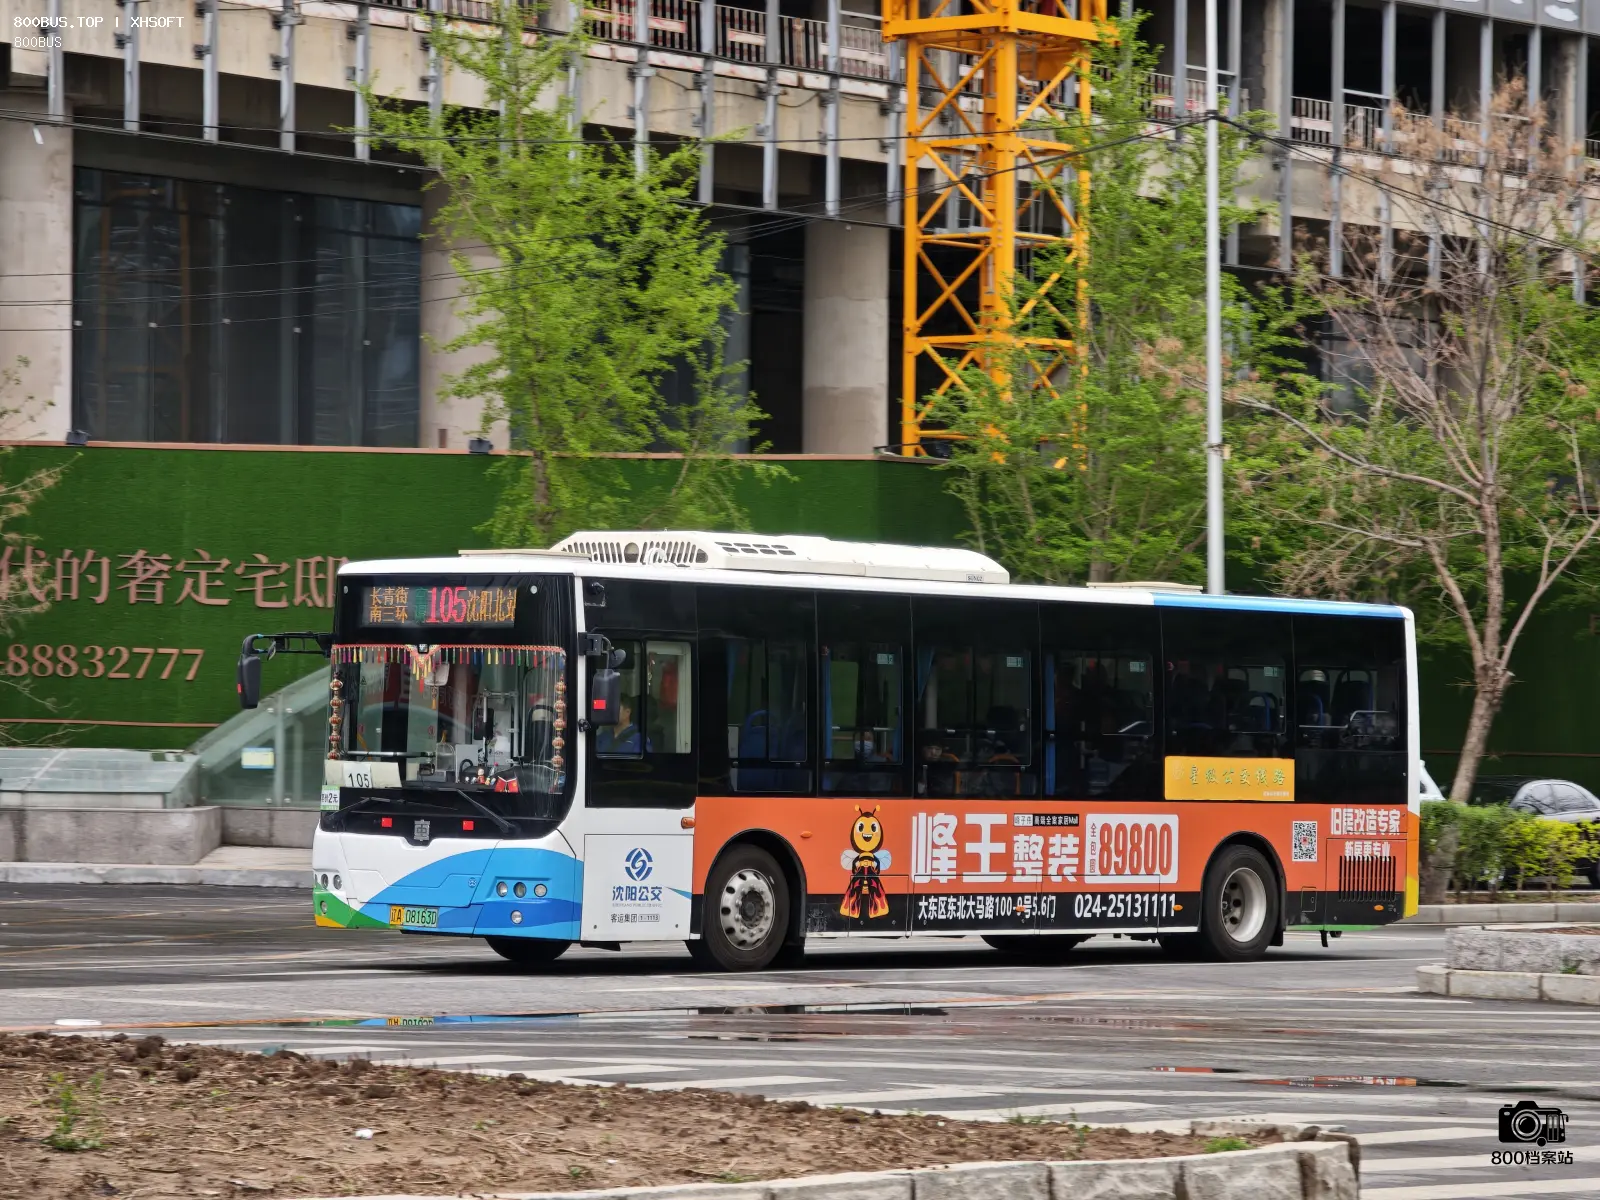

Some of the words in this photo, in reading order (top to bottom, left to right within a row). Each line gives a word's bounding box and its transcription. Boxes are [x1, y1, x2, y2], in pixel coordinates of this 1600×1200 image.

[369, 587, 409, 605] 长青街
[425, 586, 468, 624] 105
[369, 605, 409, 624] 南三环
[348, 772, 371, 788] 105
[1099, 822, 1173, 876] 89800
[612, 886, 662, 901] 沈阳公交
[1074, 893, 1175, 918] 024-25131111
[610, 913, 638, 924] 客运集团
